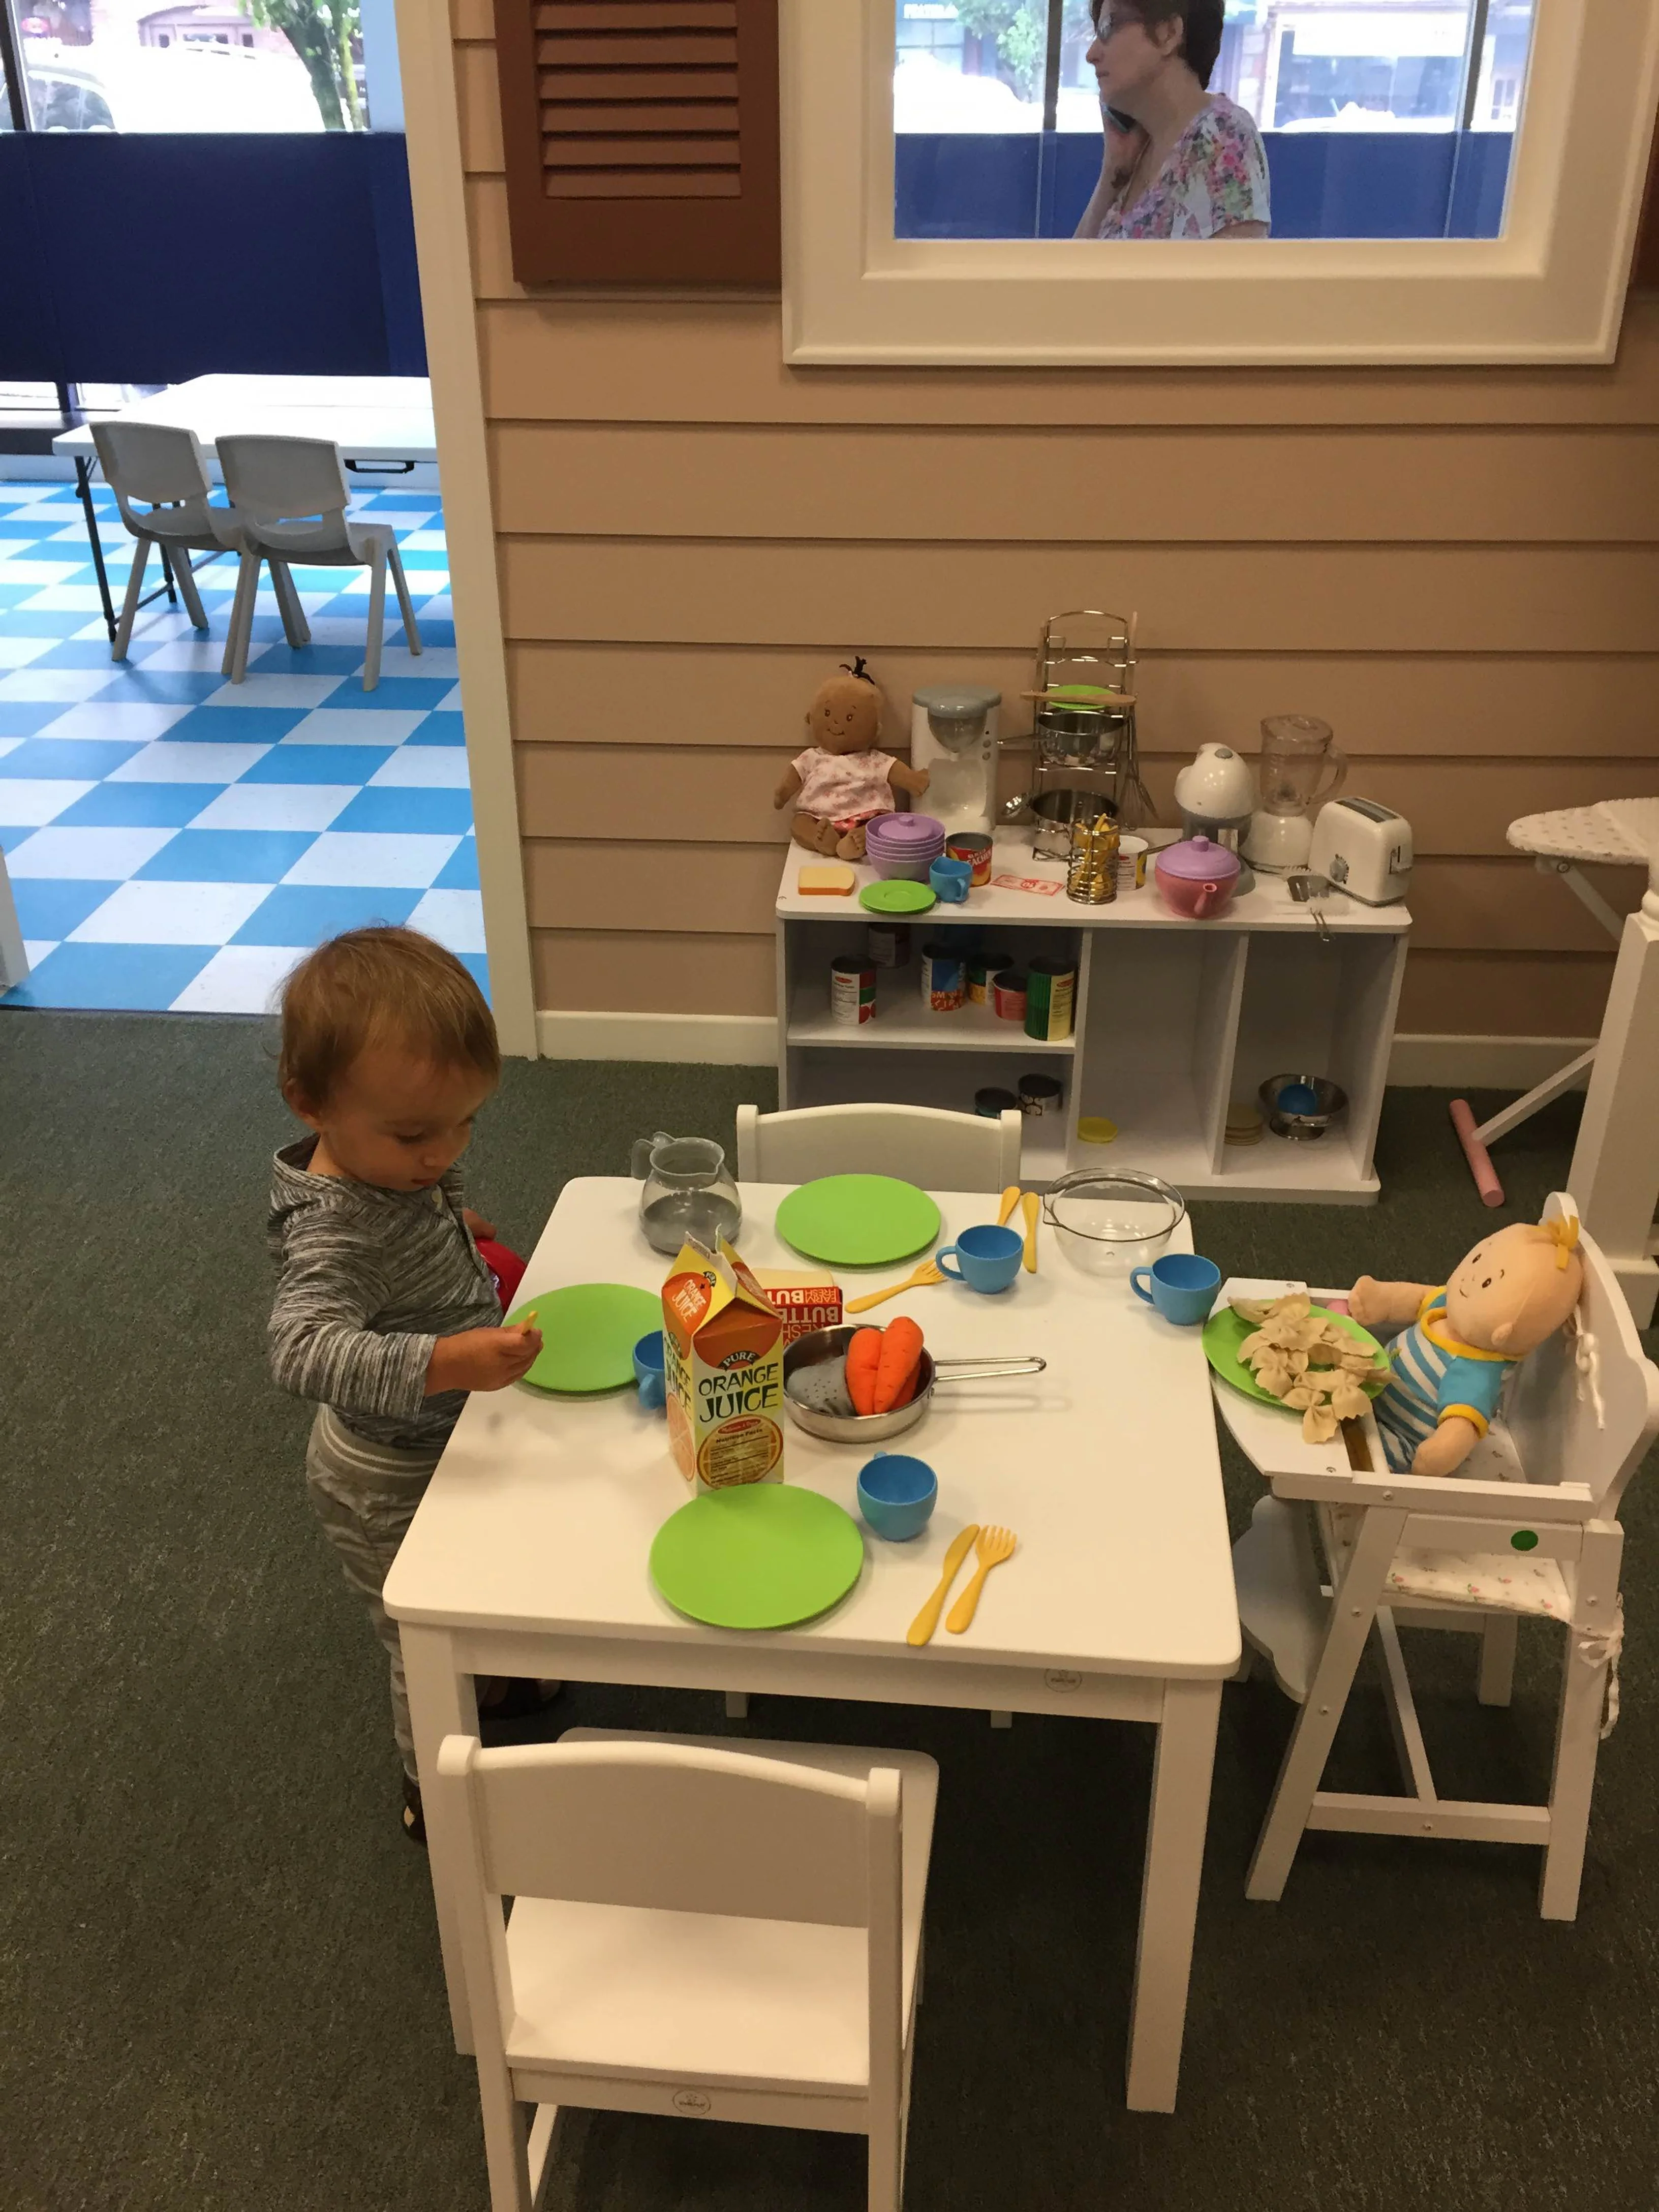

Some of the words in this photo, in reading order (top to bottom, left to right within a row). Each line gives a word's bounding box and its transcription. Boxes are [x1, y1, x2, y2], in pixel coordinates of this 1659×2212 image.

[683, 1278, 706, 1310] ORANGE
[766, 1289, 804, 1305] BUT
[805, 1288, 837, 1297] FRESH
[805, 1295, 837, 1304] FARM
[672, 1289, 697, 1323] JUICE
[777, 1306, 839, 1324] BUTTE
[723, 1351, 756, 1368] PURE
[698, 1362, 779, 1396] ORANGE
[699, 1383, 779, 1423] JUICE
